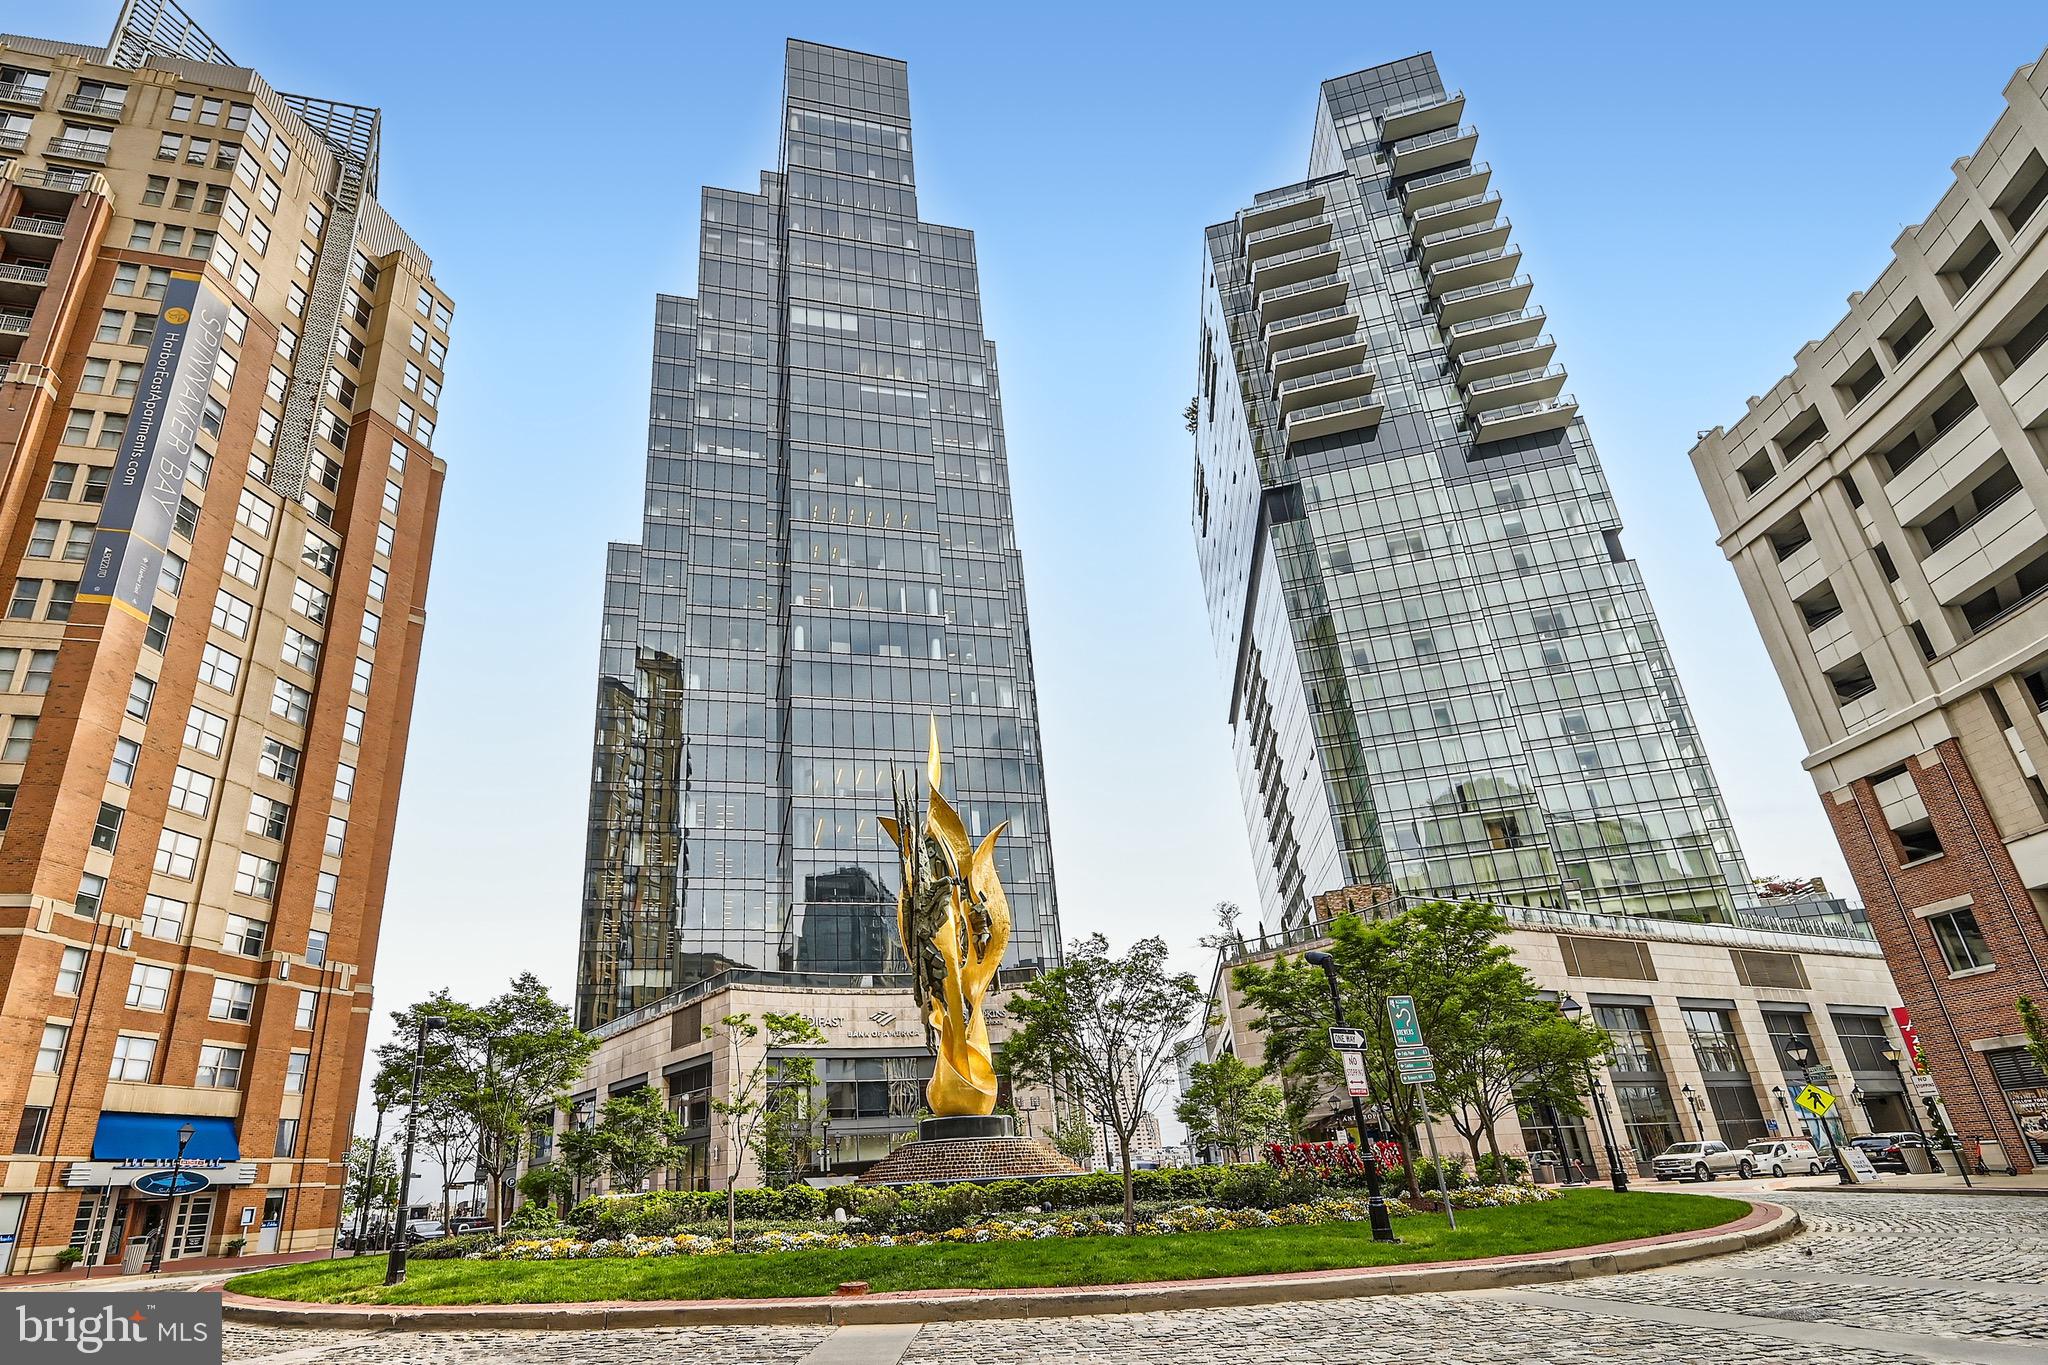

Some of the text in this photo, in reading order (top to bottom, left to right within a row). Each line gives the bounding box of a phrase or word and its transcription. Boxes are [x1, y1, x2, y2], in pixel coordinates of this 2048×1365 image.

[123, 332, 181, 486] HarborEastApartments.com
[151, 309, 221, 517] SPINNAKER BAY
[1335, 1034, 1345, 1042] ONE
[1349, 1055, 1357, 1065] NO
